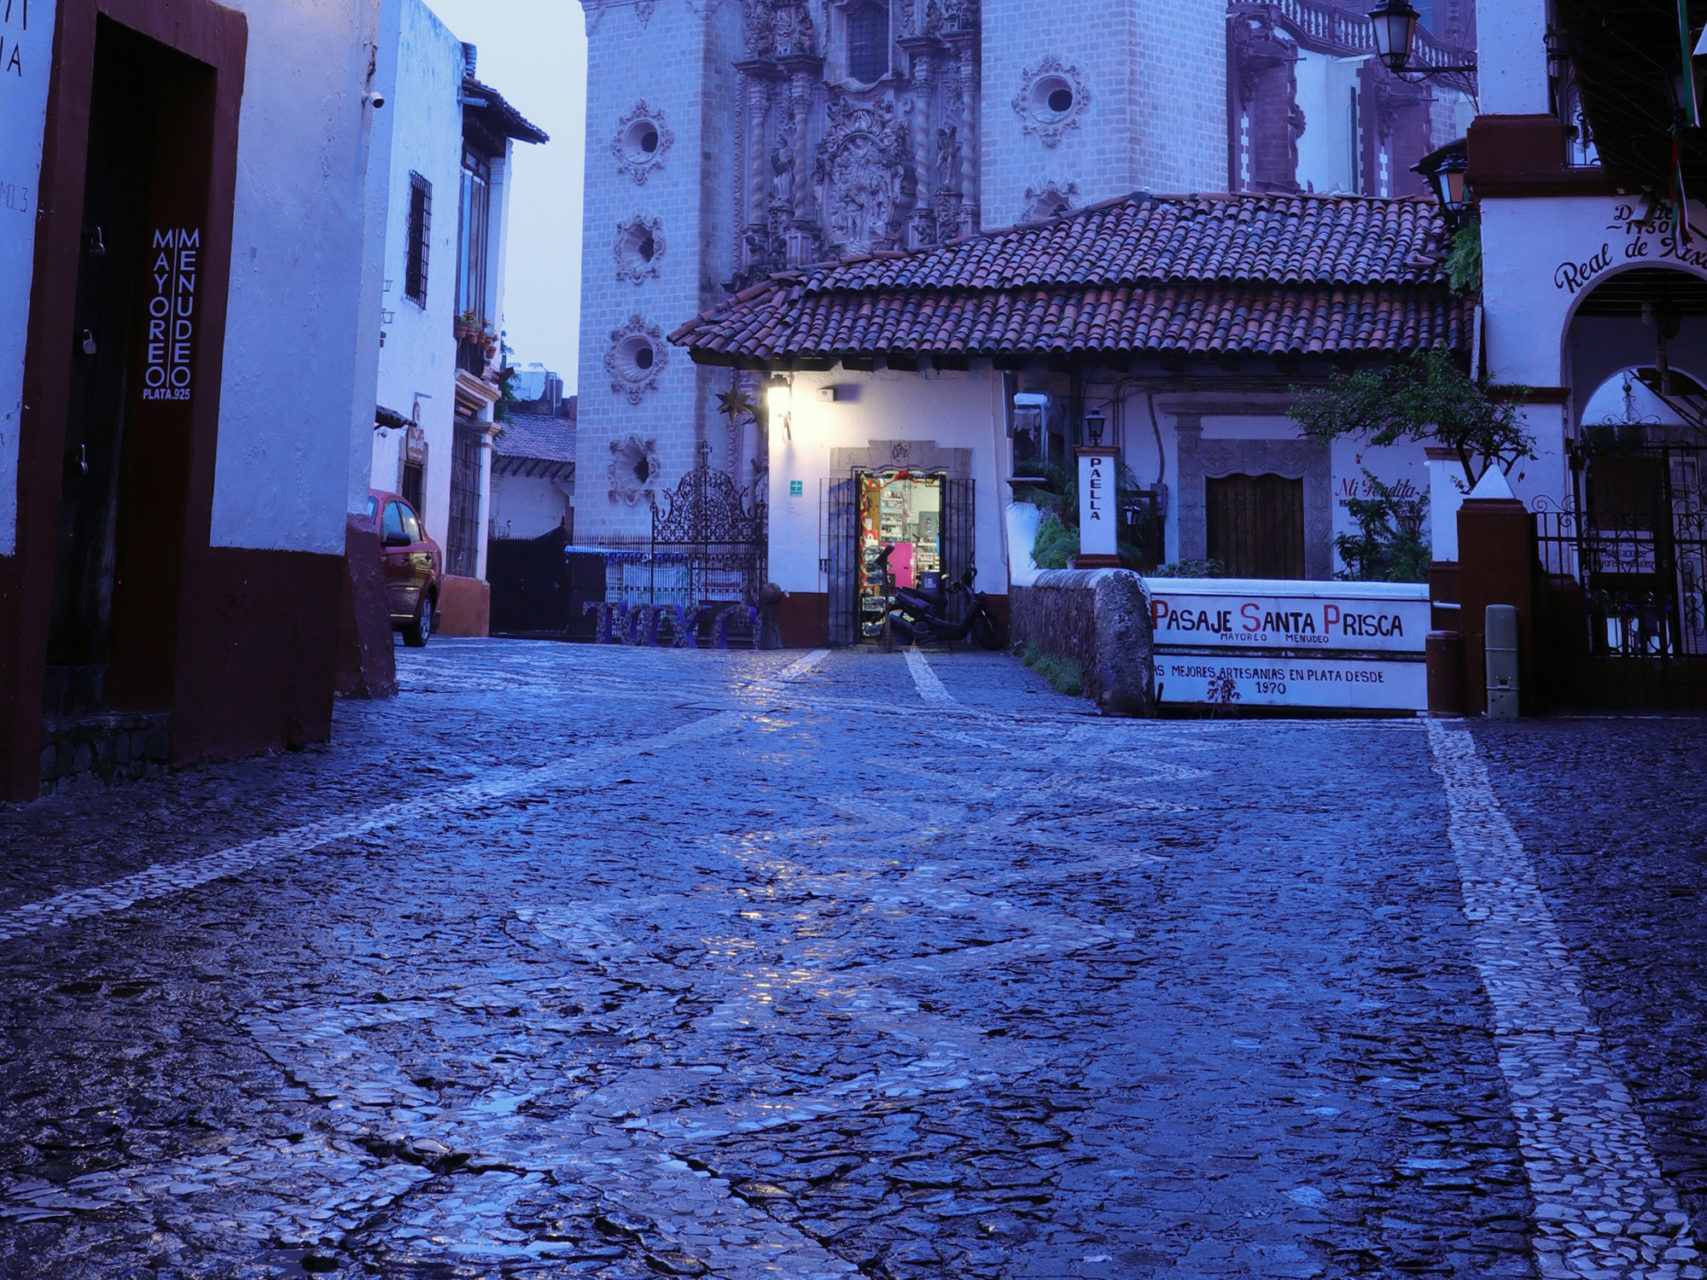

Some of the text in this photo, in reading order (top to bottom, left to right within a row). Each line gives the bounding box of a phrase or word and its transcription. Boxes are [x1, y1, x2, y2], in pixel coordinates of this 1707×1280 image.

[1554, 242, 1614, 294] Real
[1625, 235, 1649, 258] de
[145, 228, 174, 388] MAYOREO
[171, 228, 200, 388] MENUDEO
[1089, 457, 1102, 521] PAELLA
[1334, 477, 1360, 497] Mi
[1151, 599, 1404, 638] PASAJE SANTA PRISCA
[1220, 632, 1330, 644] MAYOREO MENUDEO
[1171, 664, 1217, 679] MEJORES
[1219, 666, 1286, 681] ARTESANIAS
[1289, 669, 1304, 682] EN
[1307, 670, 1343, 683] PLATA
[1345, 671, 1385, 684] DESDE
[1256, 681, 1287, 696] 1970
